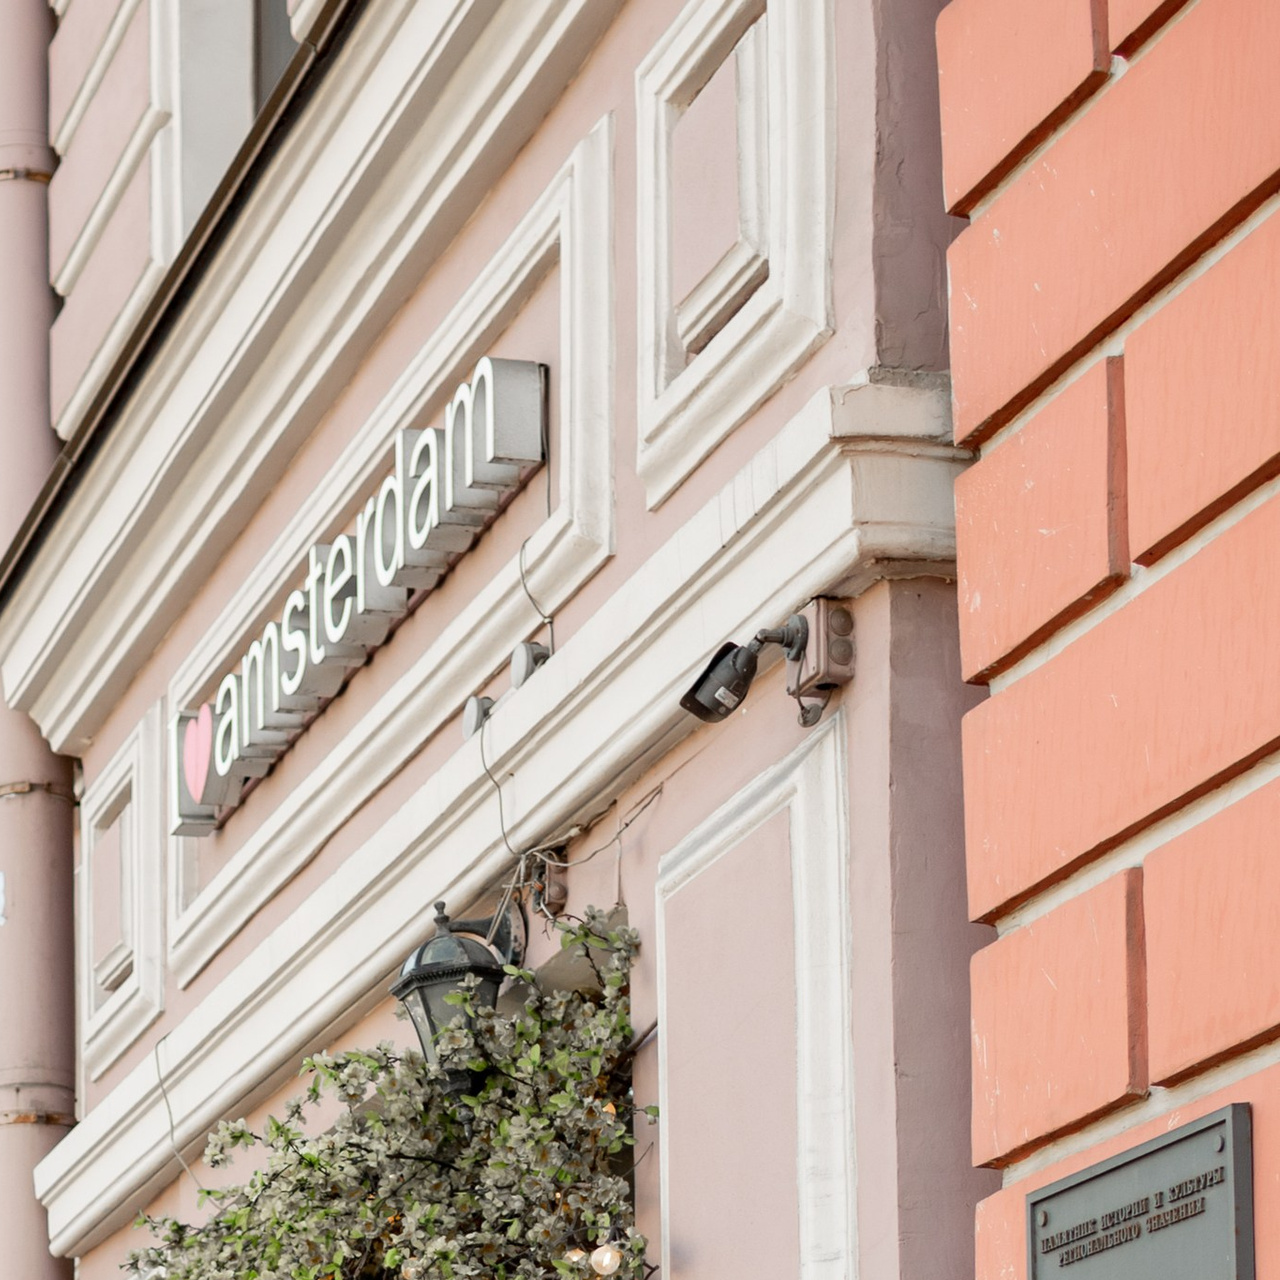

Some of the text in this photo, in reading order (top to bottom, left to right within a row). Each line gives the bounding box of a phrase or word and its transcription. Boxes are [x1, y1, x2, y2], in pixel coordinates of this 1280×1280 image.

[214, 356, 495, 777] amsterdam
[1041, 1166, 1225, 1254] ПАМЯТНИК ИСТОРИИ И КУЛЬТУРЫ
[1059, 1197, 1206, 1267] РЕГИОНАЛЬНОГО ЗНАЧЕНИЯ
